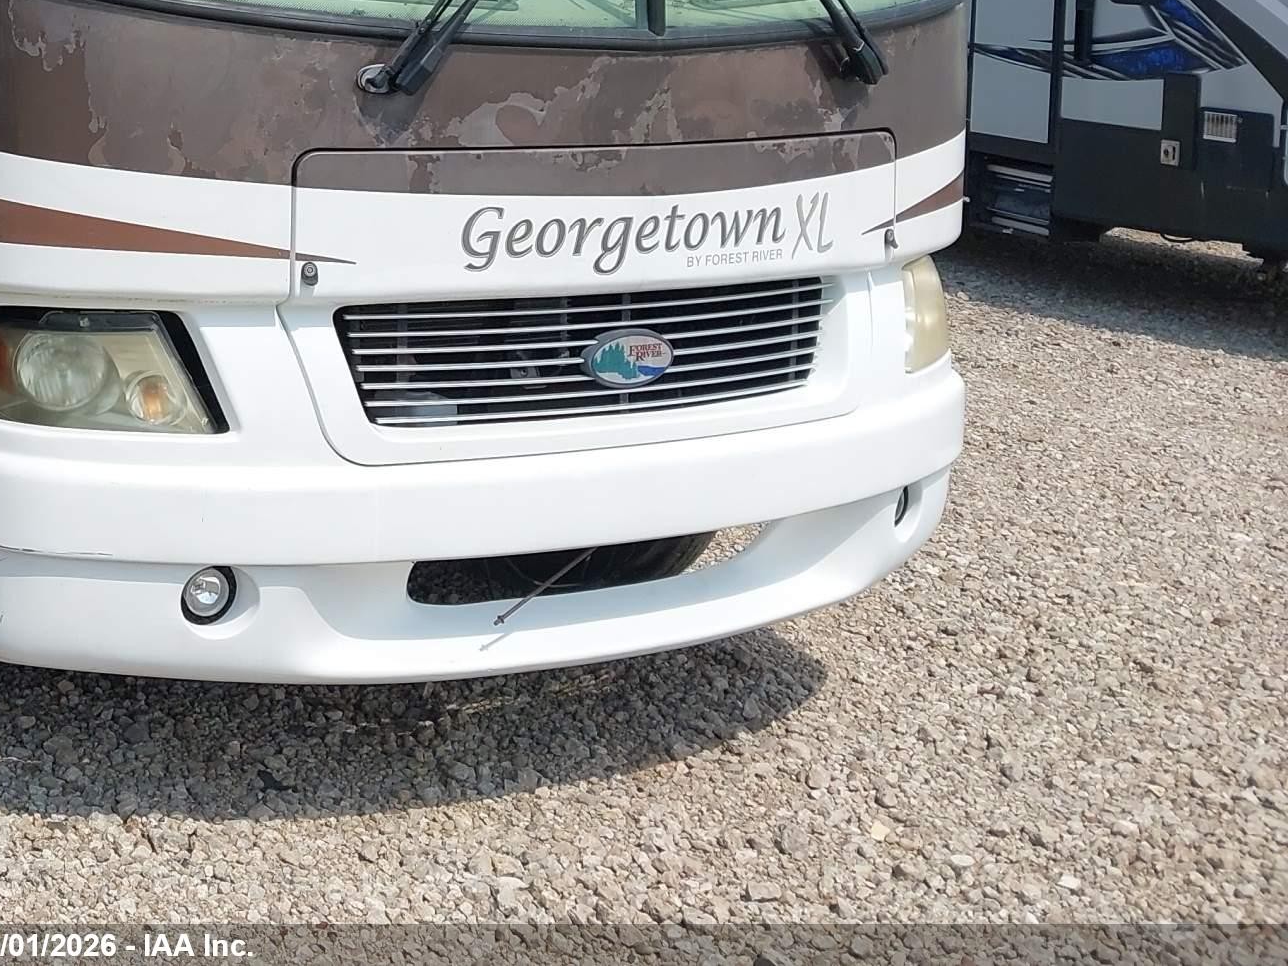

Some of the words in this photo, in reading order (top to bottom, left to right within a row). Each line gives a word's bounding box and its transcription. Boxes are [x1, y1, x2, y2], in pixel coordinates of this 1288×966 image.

[461, 203, 786, 276] Georgetown
[791, 191, 834, 259] XL
[687, 255, 702, 268] BY
[705, 251, 750, 267] FOREST
[752, 248, 783, 263] RIVER
[629, 343, 663, 357] FOREST
[636, 350, 663, 362] RIVER
